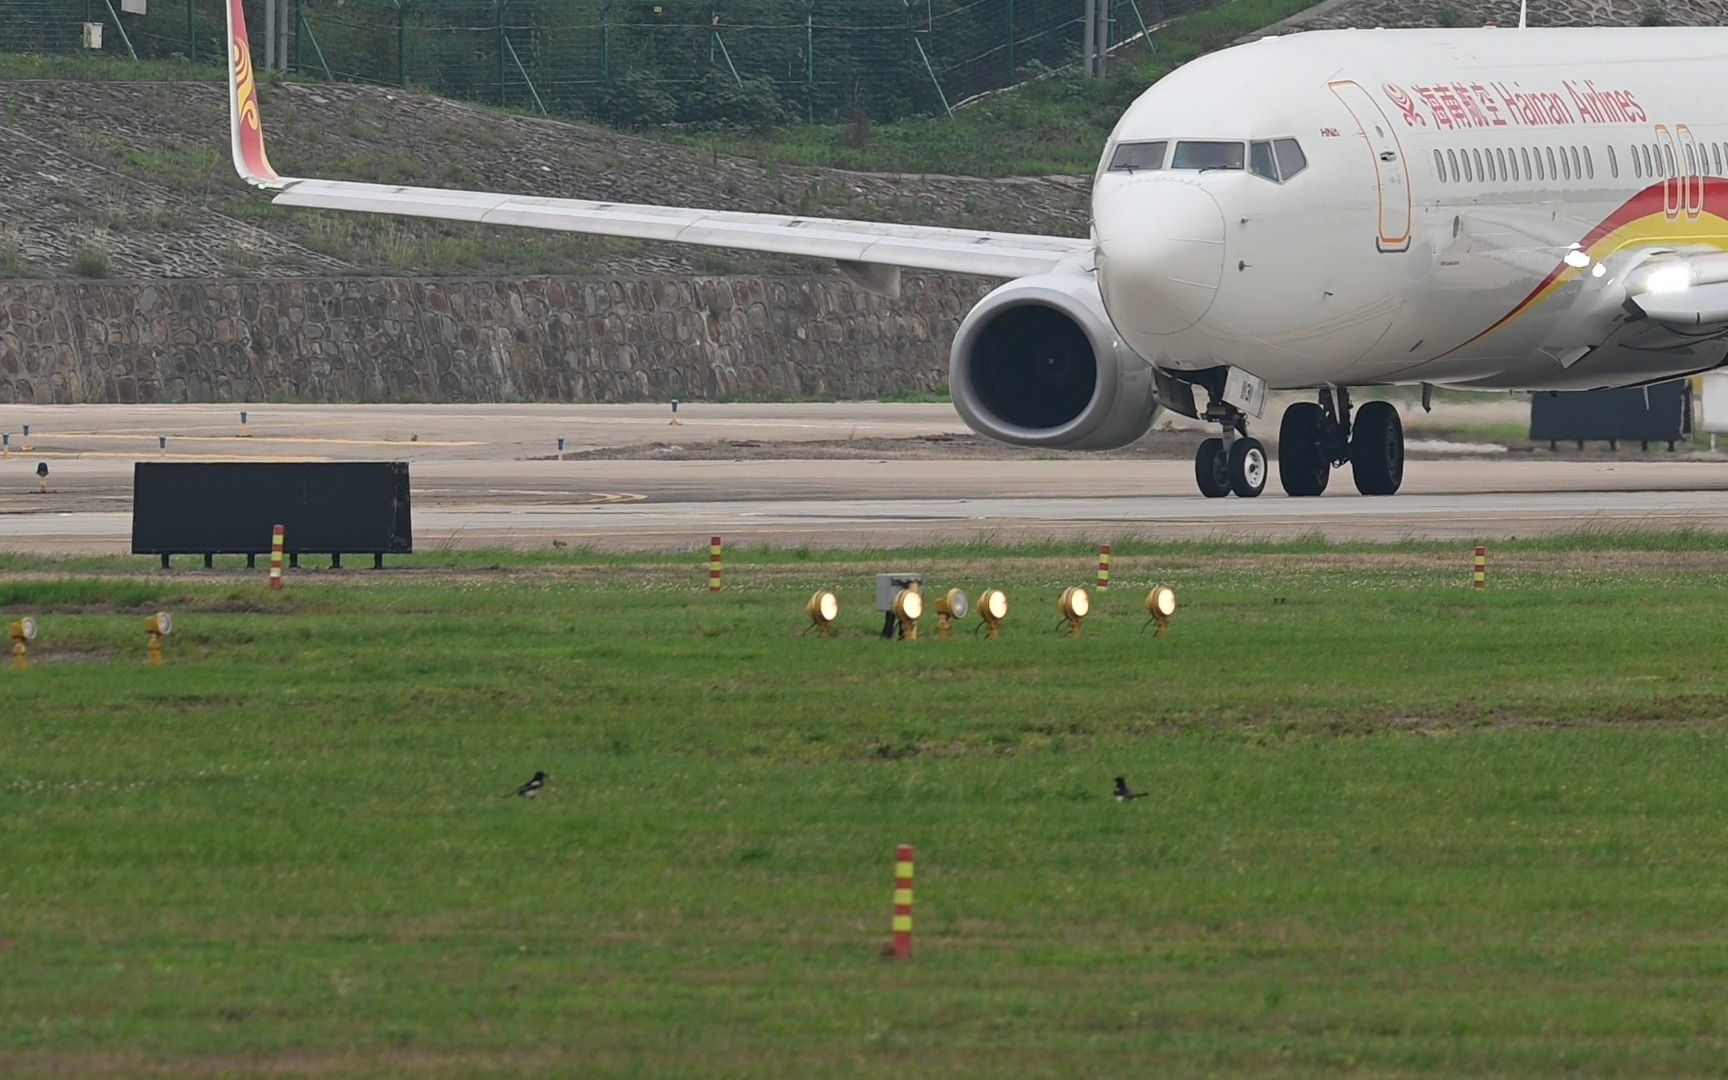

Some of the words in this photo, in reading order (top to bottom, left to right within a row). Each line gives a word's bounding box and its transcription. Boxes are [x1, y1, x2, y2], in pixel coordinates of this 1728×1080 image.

[1411, 82, 1507, 130] 海南航空
[1491, 82, 1574, 126] Hainan
[1562, 80, 1647, 124] Airlines
